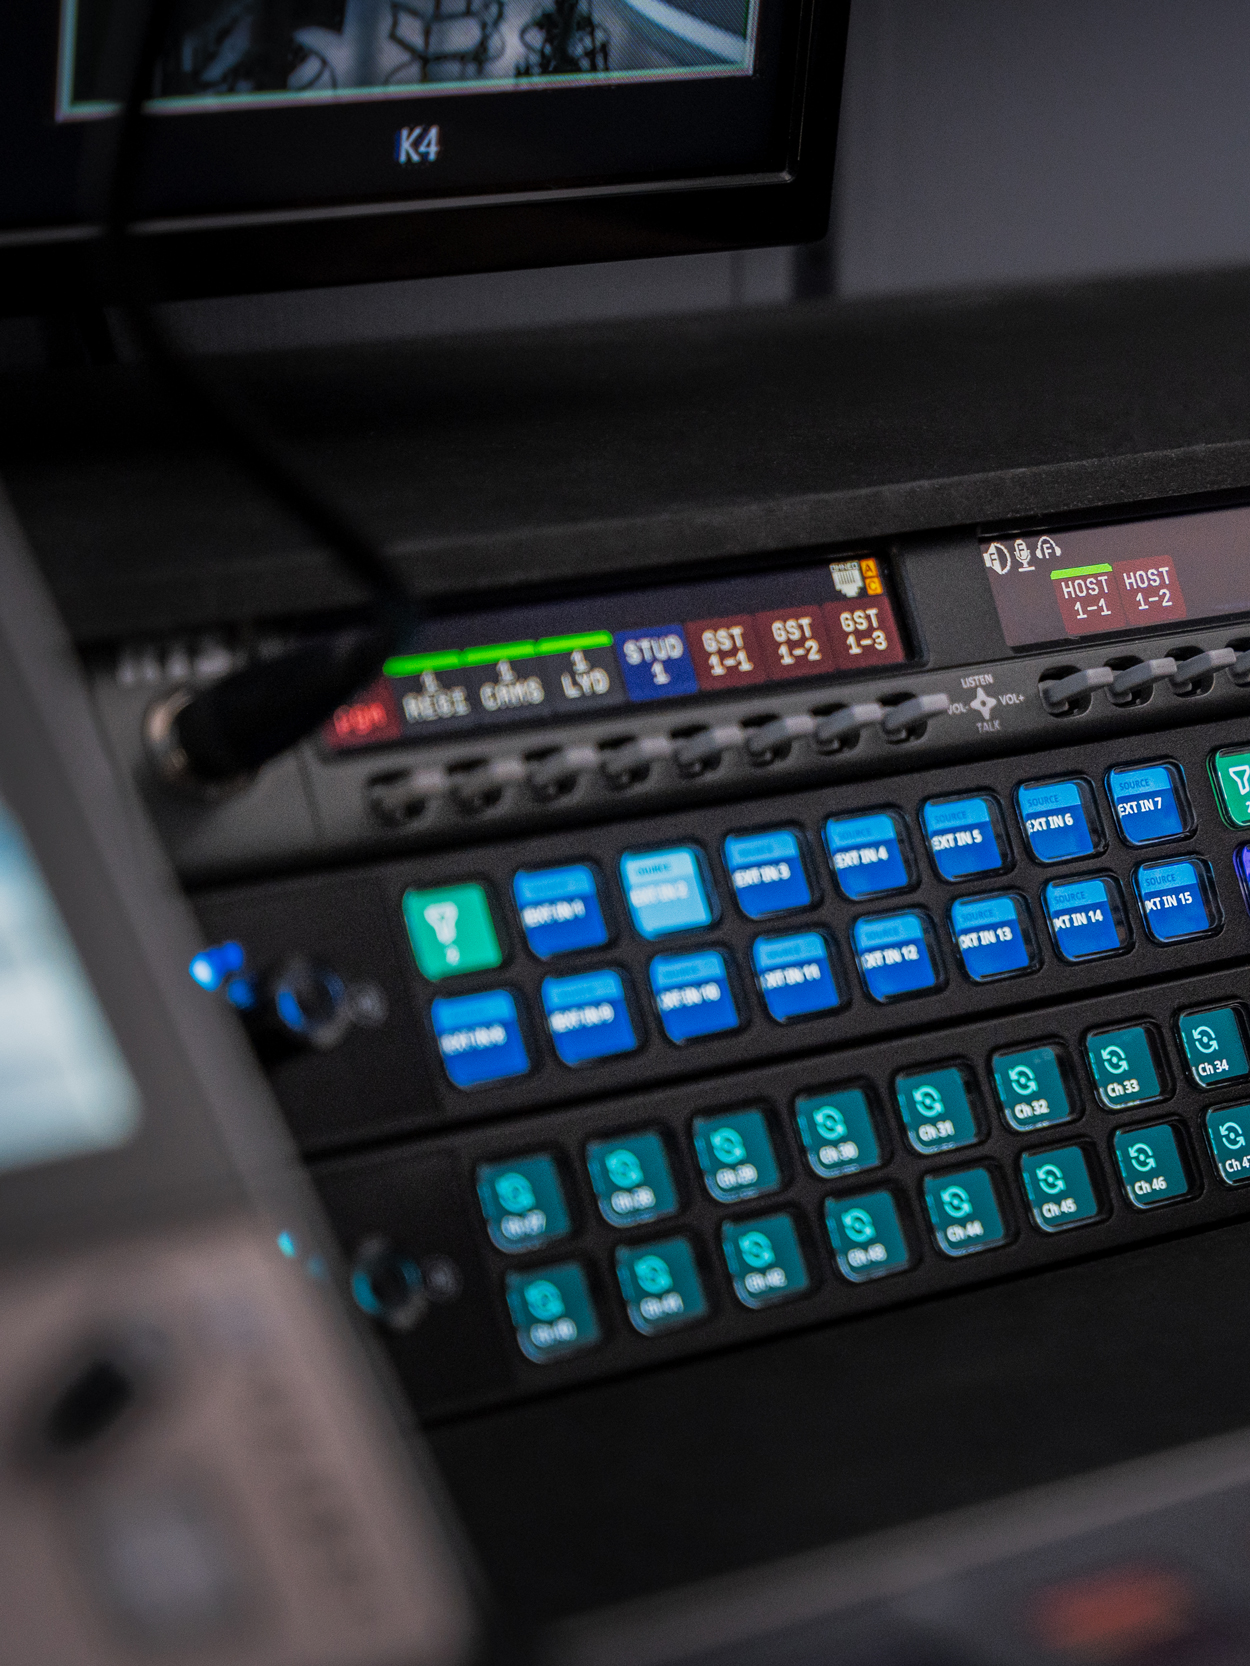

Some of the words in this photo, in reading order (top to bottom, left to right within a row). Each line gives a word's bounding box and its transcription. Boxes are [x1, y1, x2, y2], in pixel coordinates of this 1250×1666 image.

[399, 125, 440, 163] K4
[1061, 575, 1109, 599] HOST
[1123, 567, 1169, 590] HOST
[1074, 598, 1112, 619] 1-1
[1136, 588, 1173, 610] 1-2
[771, 616, 812, 643] GST
[839, 608, 879, 633] GST
[701, 625, 744, 653] GST
[845, 629, 888, 655] 1-3
[623, 634, 684, 666] STUD
[777, 638, 822, 666] 1-2
[707, 649, 754, 676] 1-1
[651, 661, 671, 685] 1
[961, 673, 994, 689] LISTEN
[999, 693, 1025, 706] VOL+
[976, 719, 1001, 734] TALK
[1119, 778, 1150, 791] SOURCE
[1027, 794, 1059, 807] SOURCE
[1139, 799, 1154, 812] IN
[1154, 797, 1162, 809] 7
[1047, 814, 1065, 829] IN
[1065, 812, 1074, 826] 6
[972, 829, 983, 843] 5
[1145, 873, 1177, 887] SOURCE
[1053, 891, 1086, 904] SOURCE
[1162, 894, 1178, 908] IN
[1178, 891, 1193, 905] 15
[1071, 912, 1088, 926] IN
[1088, 909, 1103, 923] 14
[997, 926, 1013, 941] 13
[1198, 1061, 1214, 1076] Ch
[1215, 1059, 1229, 1073] 34
[1107, 1081, 1124, 1097] Ch
[1122, 1079, 1140, 1094] 33
[1014, 1102, 1032, 1119] Ch
[1030, 1099, 1050, 1117] 32
[918, 1123, 938, 1142] Ch
[1225, 1158, 1241, 1173] Ch
[1134, 1180, 1151, 1195] Ch
[1150, 1176, 1168, 1192] 46
[1042, 1200, 1060, 1218] Ch
[1059, 1198, 1077, 1214] 45
[946, 1223, 965, 1242] Ch
